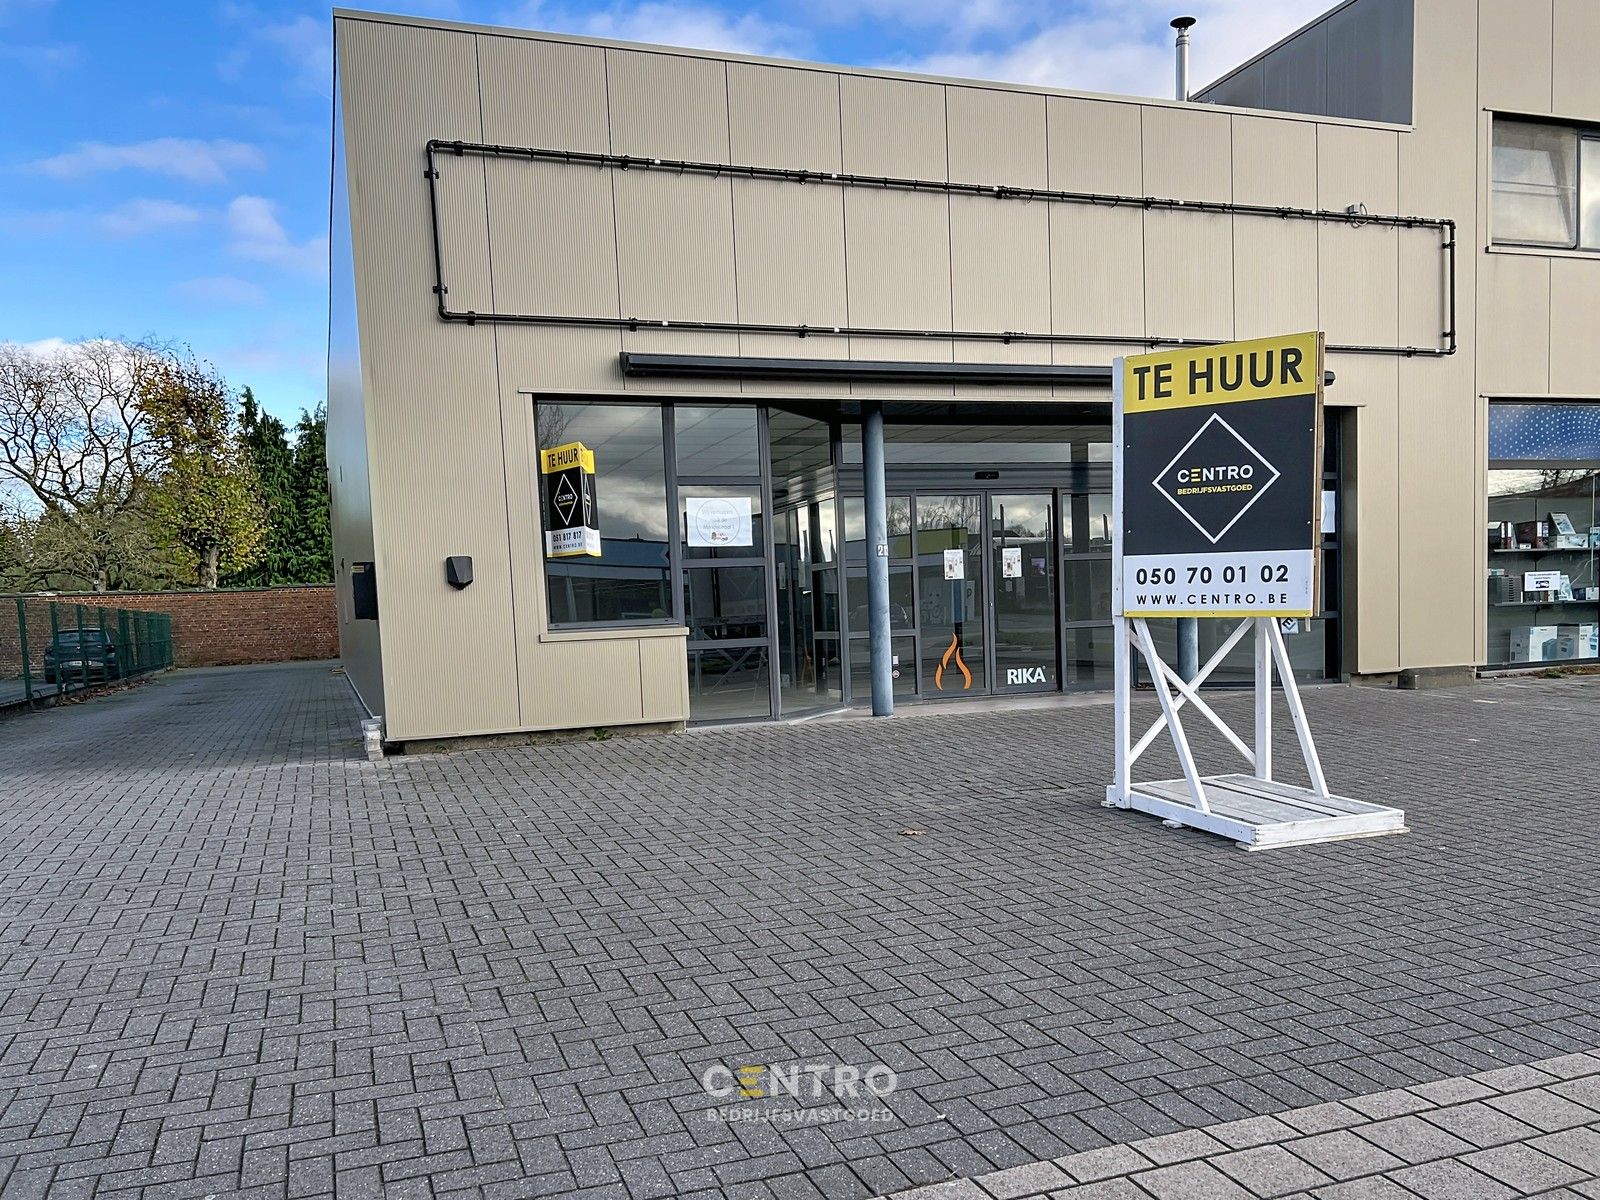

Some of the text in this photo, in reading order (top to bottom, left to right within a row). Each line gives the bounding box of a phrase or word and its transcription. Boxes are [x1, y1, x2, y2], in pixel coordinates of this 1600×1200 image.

[1133, 348, 1303, 400] TE HUUR
[548, 454, 556, 468] TE
[557, 448, 578, 464] HUUR
[1177, 464, 1254, 483] CENTRO
[1177, 484, 1253, 495] BEDRIJFSVASTGOED
[563, 532, 571, 541] 817
[573, 531, 582, 540] 817
[1136, 564, 1289, 585] 050 70 01 02
[1136, 593, 1288, 604] WWW.CENTRO.BE
[1007, 667, 1047, 684] RIKA
